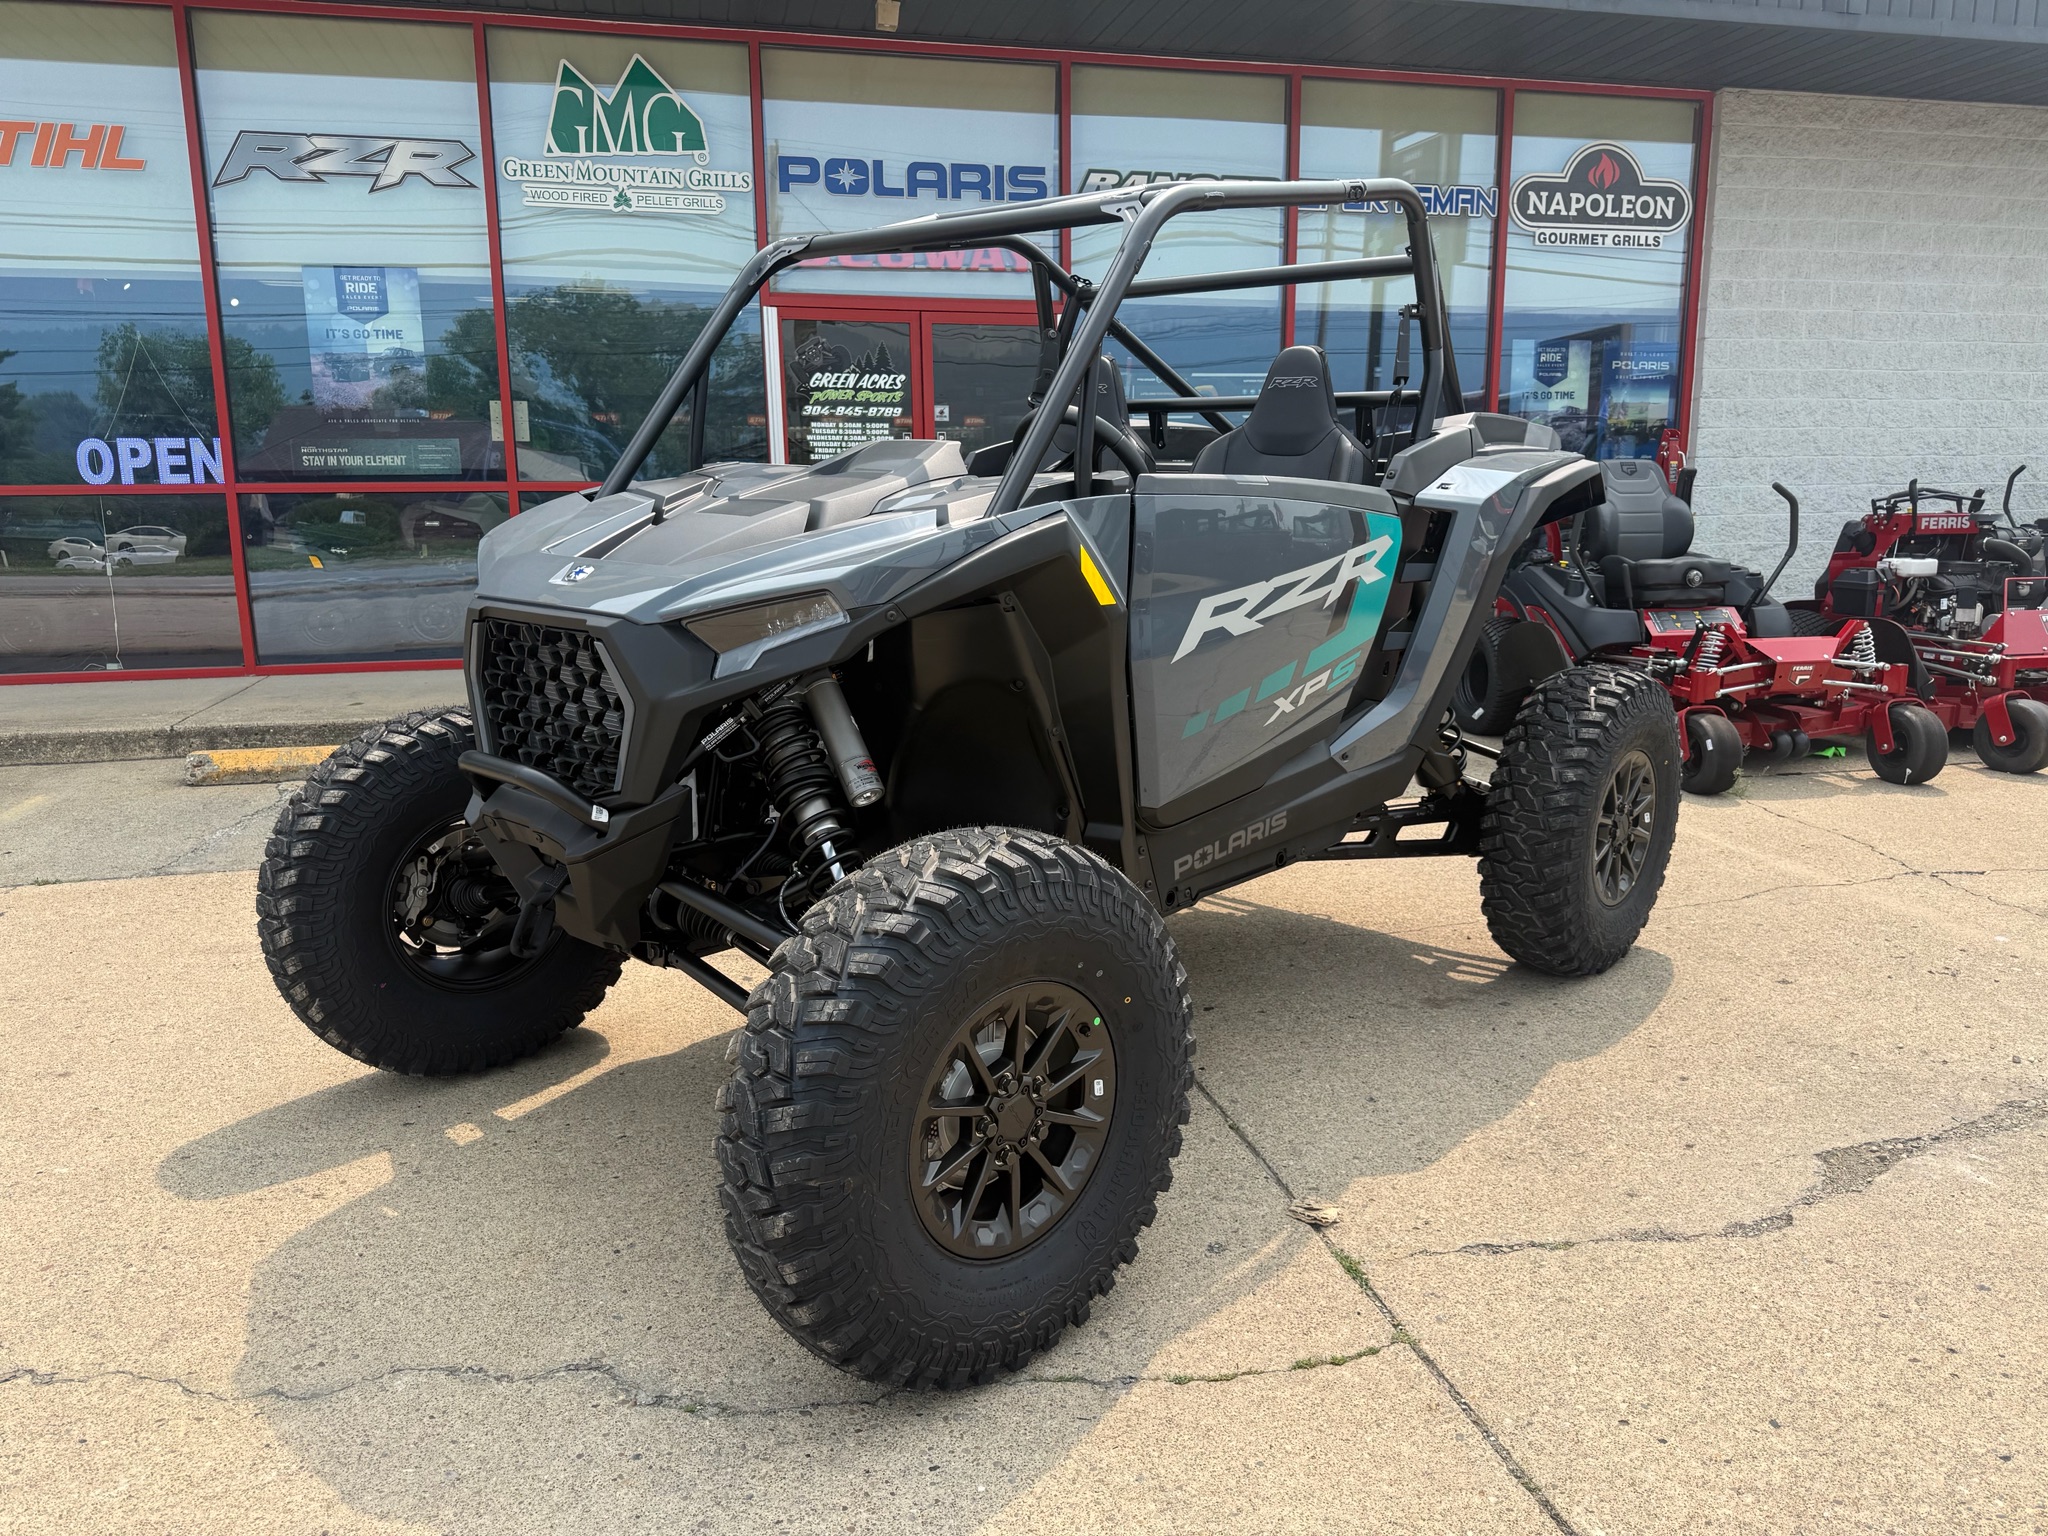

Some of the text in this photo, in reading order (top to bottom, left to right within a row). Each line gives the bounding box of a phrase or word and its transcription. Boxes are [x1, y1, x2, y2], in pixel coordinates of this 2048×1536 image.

[545, 68, 708, 157] GMG
[0, 120, 146, 171] TIHL
[212, 129, 480, 194] RZR
[503, 159, 751, 190] GREEN MOUNTAIN GRILLS
[777, 155, 1049, 201] POLARIS
[530, 189, 724, 209] WOOD FIRED PELLET GRILLS
[1527, 190, 1675, 220] NAPOLEON
[1537, 231, 1661, 248] GOURMET GRILLS
[345, 282, 377, 294] RIDE
[326, 328, 404, 340] IT'S GO TIME
[1540, 353, 1562, 362] RIDE
[1612, 360, 1670, 370] POLARIS
[809, 372, 906, 389] GREEN ACRES
[1268, 376, 1318, 390] RZR
[809, 389, 905, 405] POWER SPORTS
[1540, 391, 1552, 400] GO
[1555, 391, 1575, 400] TIME
[802, 405, 902, 417] 304-845-8789
[76, 437, 226, 485] OPEN
[302, 455, 325, 466] STAY
[327, 455, 338, 466] IN
[339, 455, 364, 466] YOUR
[365, 455, 407, 466] ELEMENT
[1921, 516, 1971, 529] FERRIS
[1171, 534, 1394, 664] RZR
[701, 717, 734, 745] POLARIS
[1174, 811, 1287, 880] POLARIS
